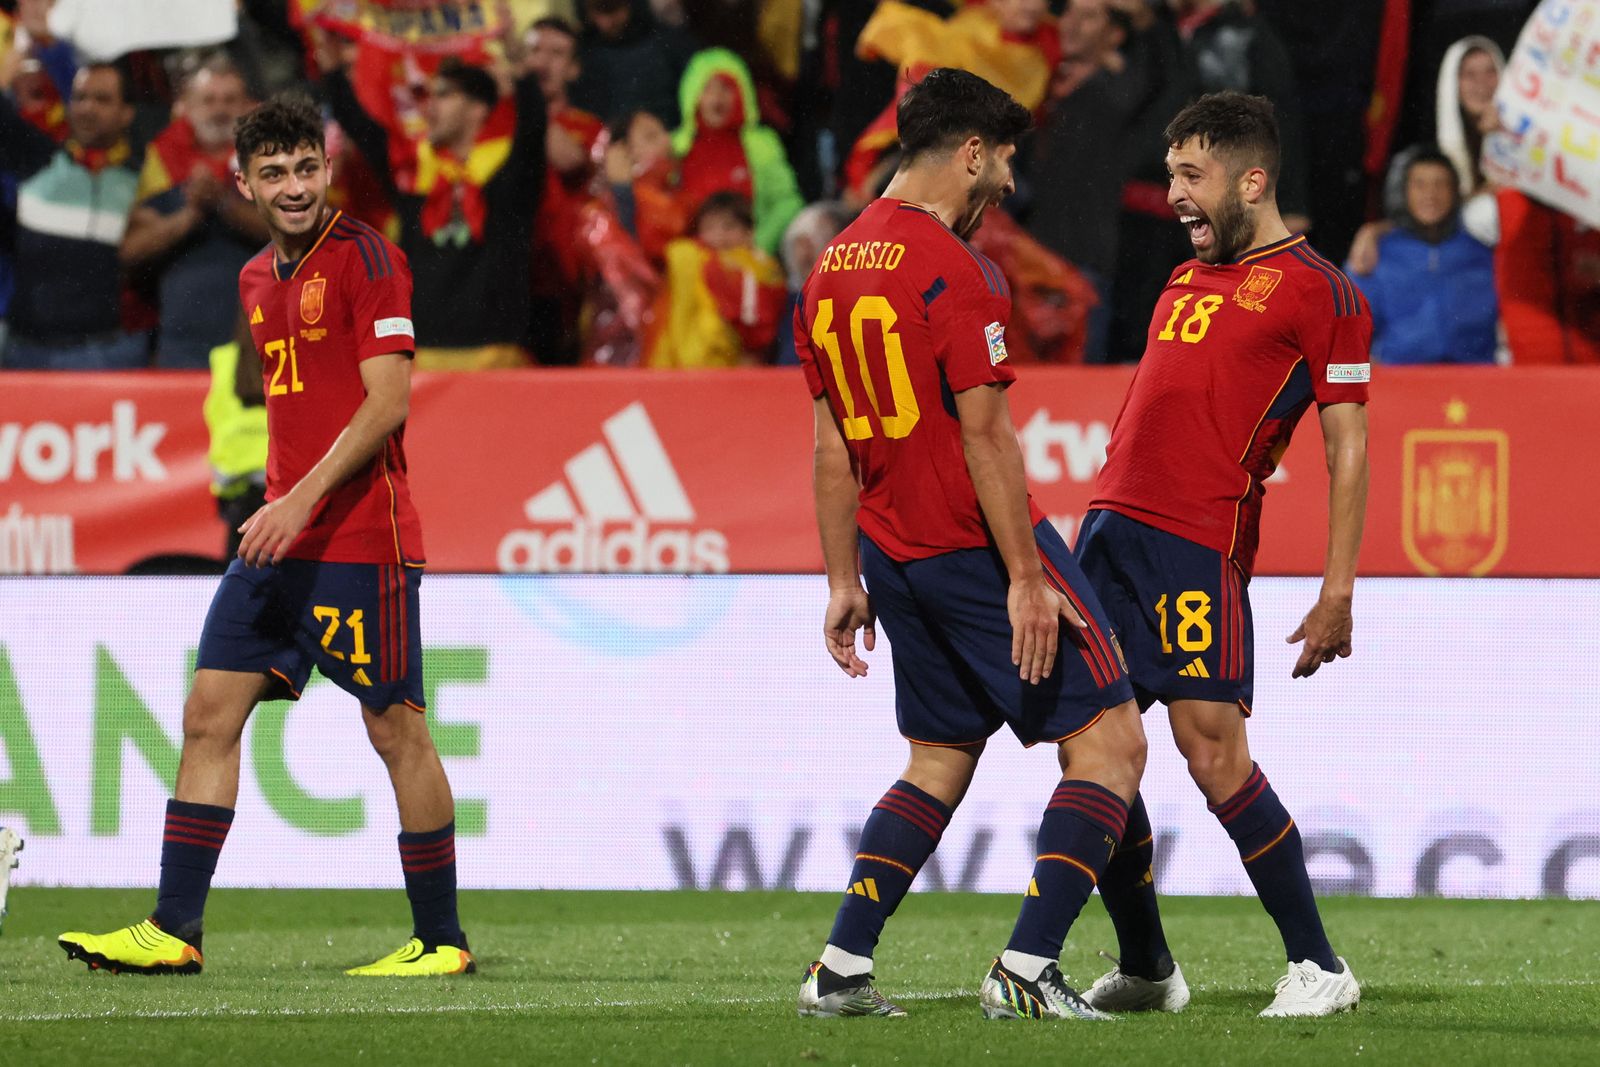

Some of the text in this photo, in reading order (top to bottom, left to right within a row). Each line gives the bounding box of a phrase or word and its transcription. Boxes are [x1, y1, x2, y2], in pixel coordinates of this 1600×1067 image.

[819, 241, 906, 274] ASENSIO
[1157, 293, 1224, 344] 18
[264, 336, 304, 397] 21
[811, 295, 921, 440] 10
[496, 517, 731, 575] adidas
[313, 605, 372, 664] 21
[1155, 590, 1213, 654] 18
